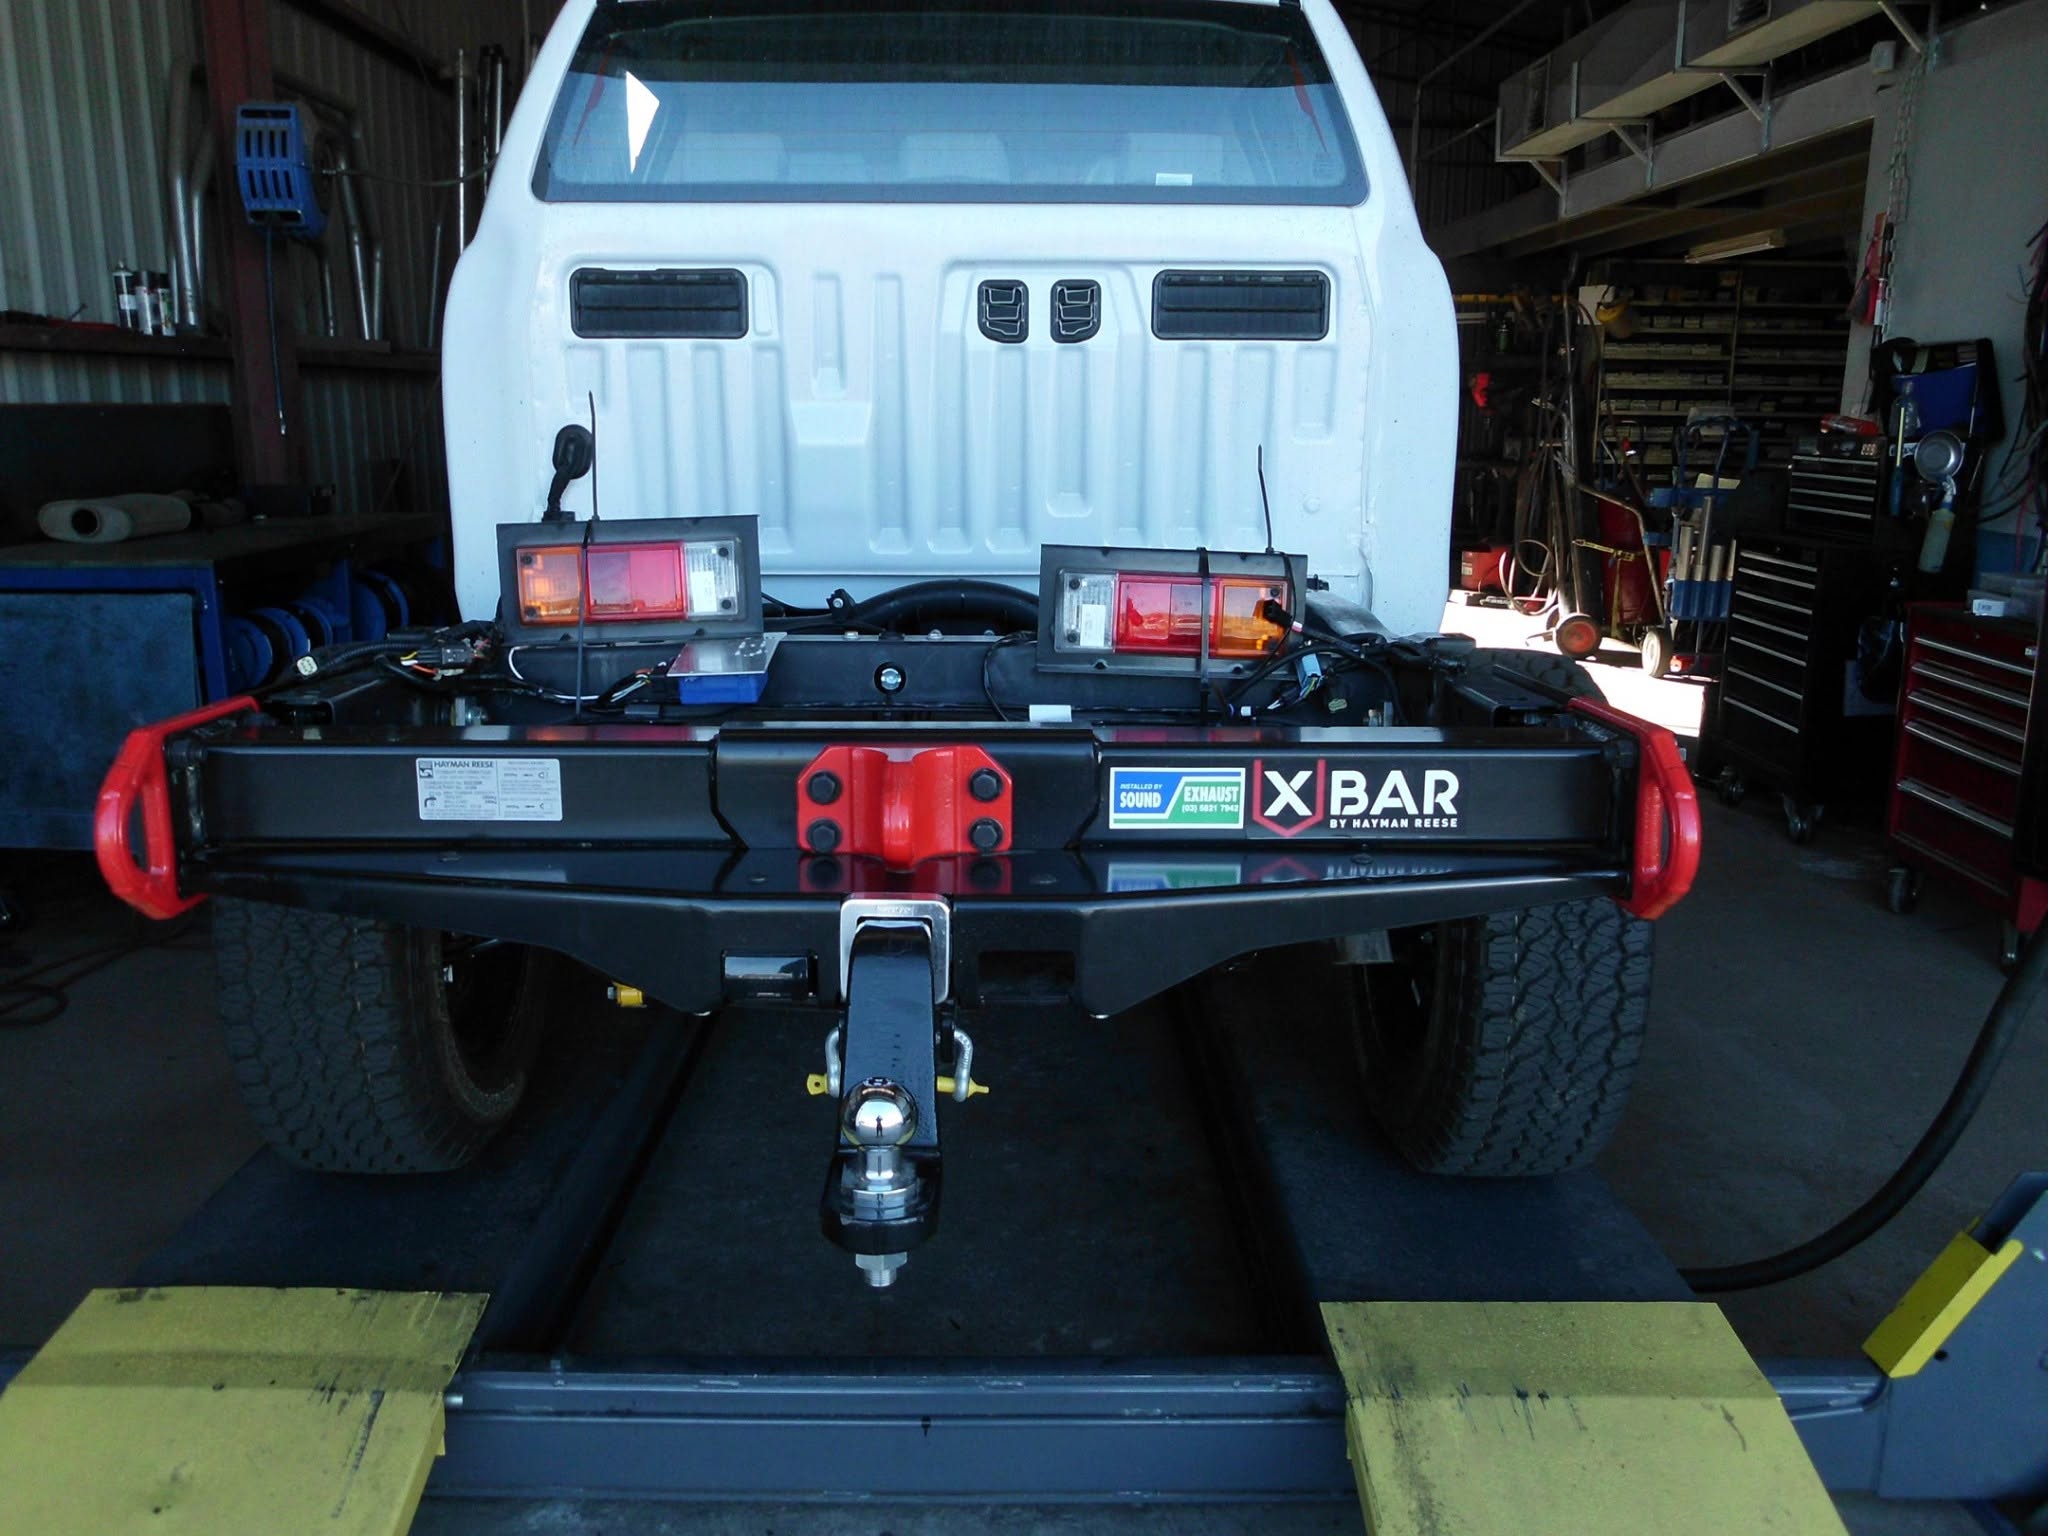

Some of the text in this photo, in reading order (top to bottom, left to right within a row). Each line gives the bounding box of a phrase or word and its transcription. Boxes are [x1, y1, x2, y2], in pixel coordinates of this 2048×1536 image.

[1120, 792, 1161, 808] SOUND
[1183, 786, 1239, 803] EXHAUST
[1263, 769, 1460, 817] X BAR
[1329, 818, 1458, 829] BY HAYMAN REESE
